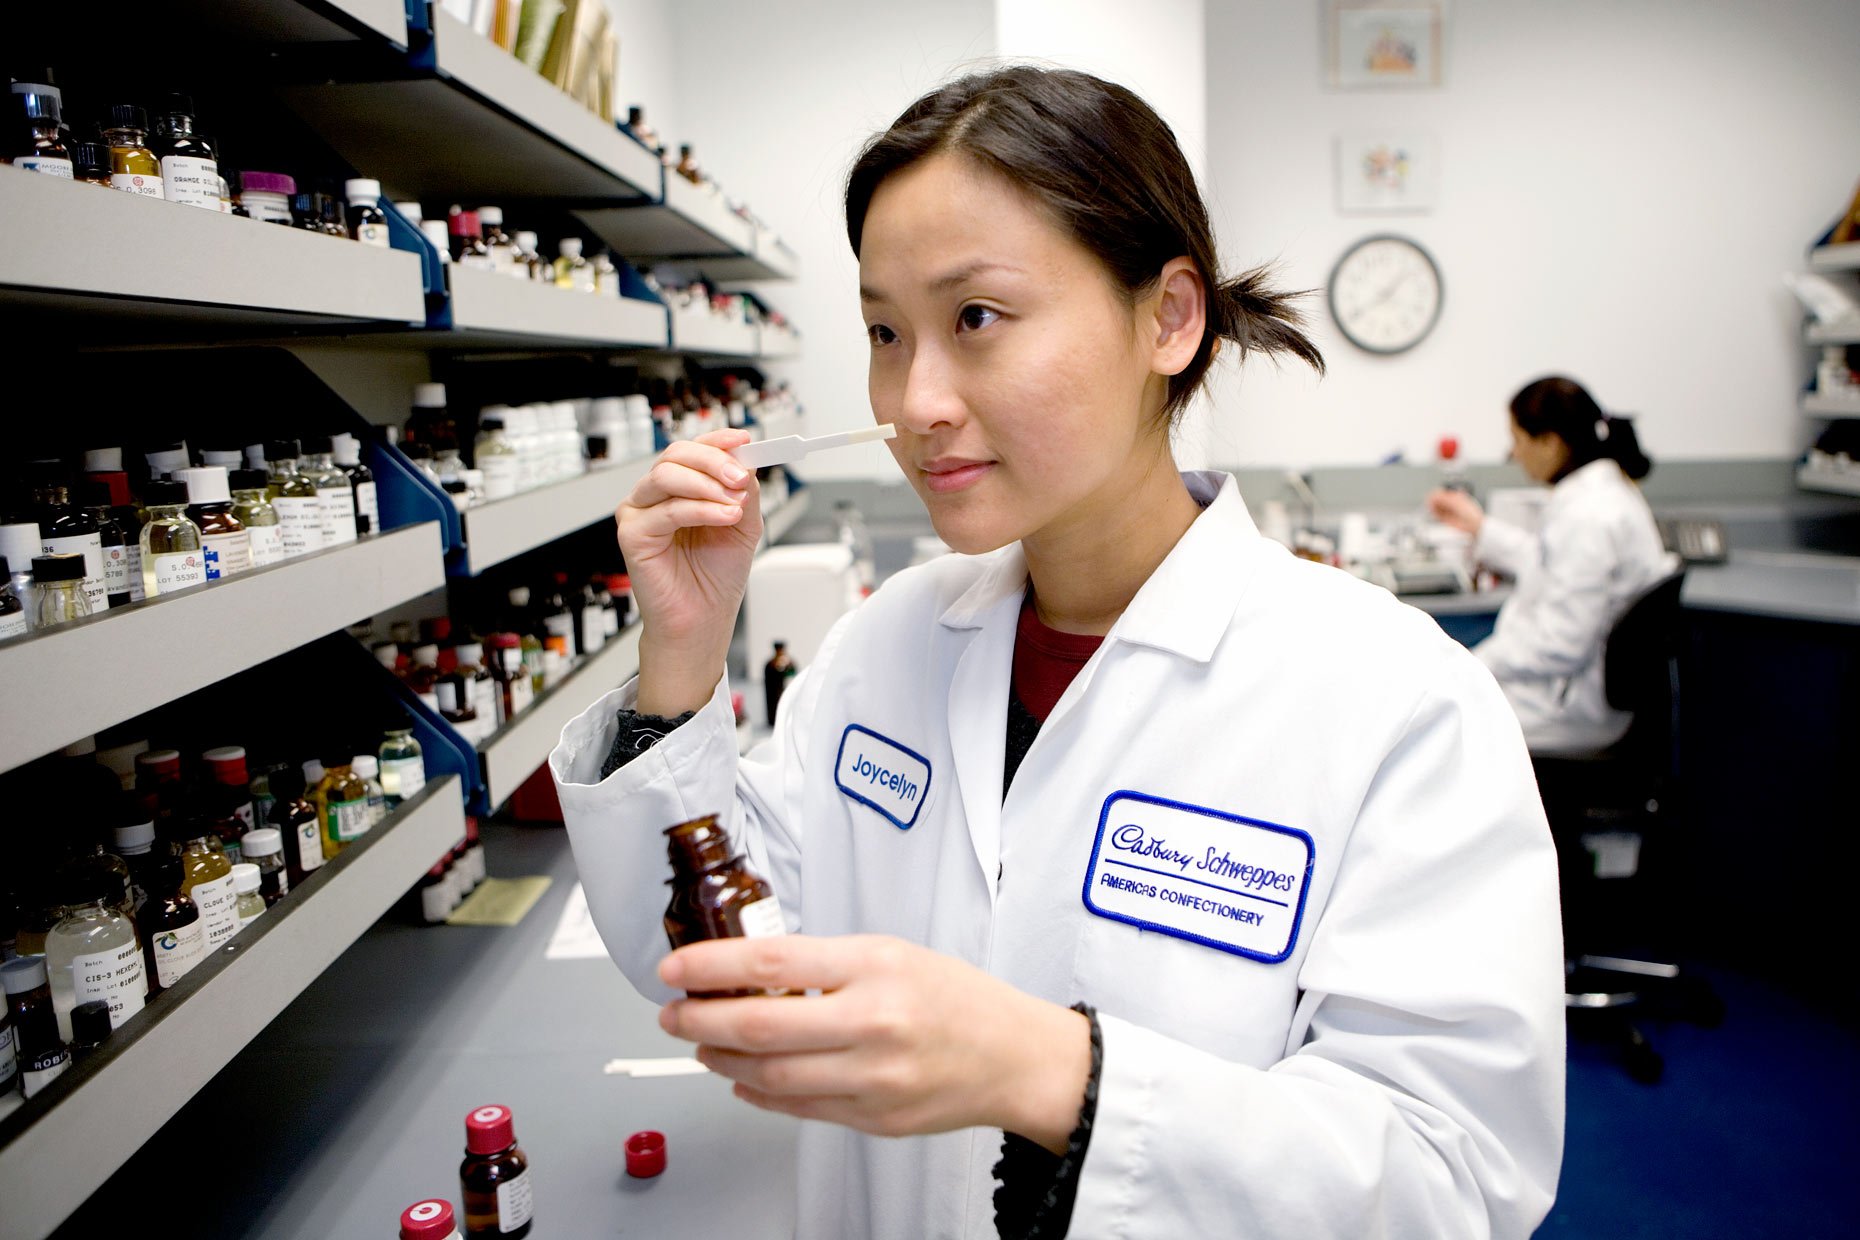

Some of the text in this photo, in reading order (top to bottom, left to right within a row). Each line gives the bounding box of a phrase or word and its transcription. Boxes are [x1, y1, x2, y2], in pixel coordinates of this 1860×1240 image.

[852, 753, 918, 802] Joycelyn
[1111, 824, 1296, 892] Cadbury Schweppes
[204, 897, 224, 908] CLOVE
[1100, 873, 1264, 927] AMERICAS CONFECTIONERY
[86, 972, 111, 983] CIS-3
